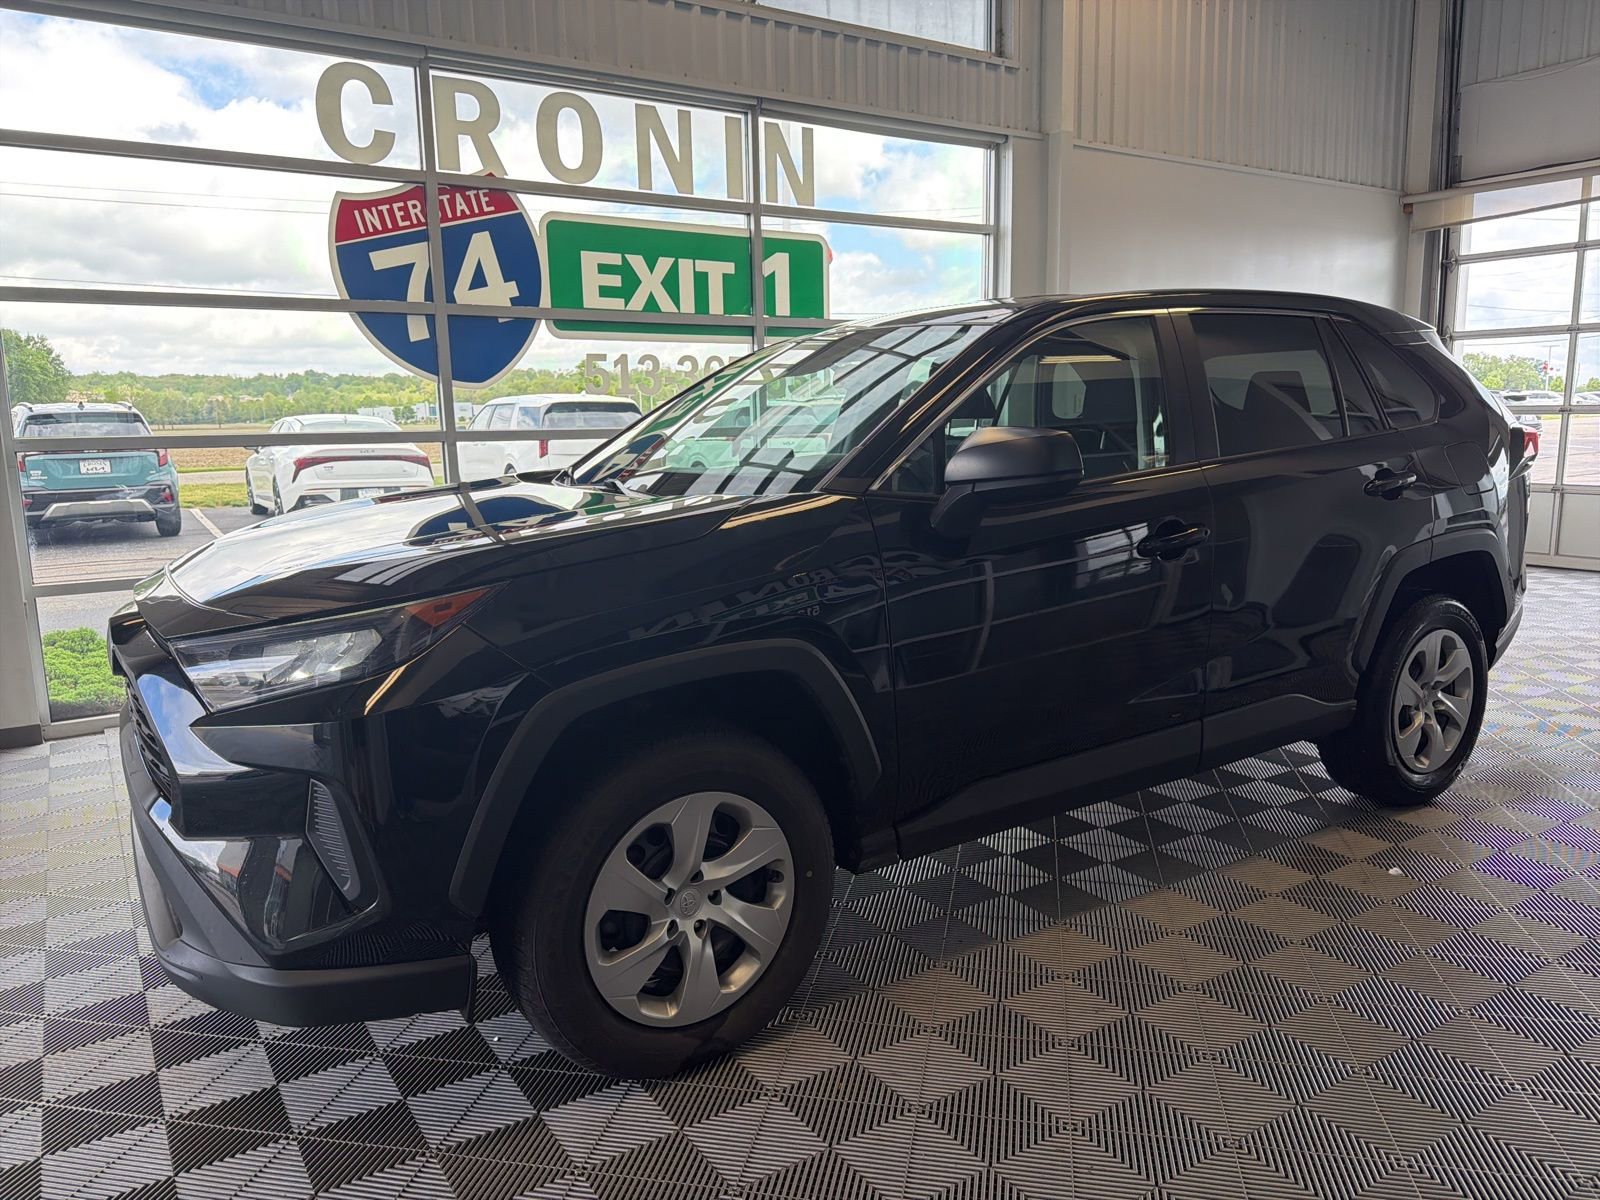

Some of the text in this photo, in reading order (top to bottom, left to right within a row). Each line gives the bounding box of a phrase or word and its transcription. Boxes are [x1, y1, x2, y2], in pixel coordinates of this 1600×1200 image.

[316, 62, 814, 206] CRONIN
[354, 189, 495, 234] INTERTATE
[369, 231, 519, 342] 74
[580, 251, 789, 316] EXIT 1
